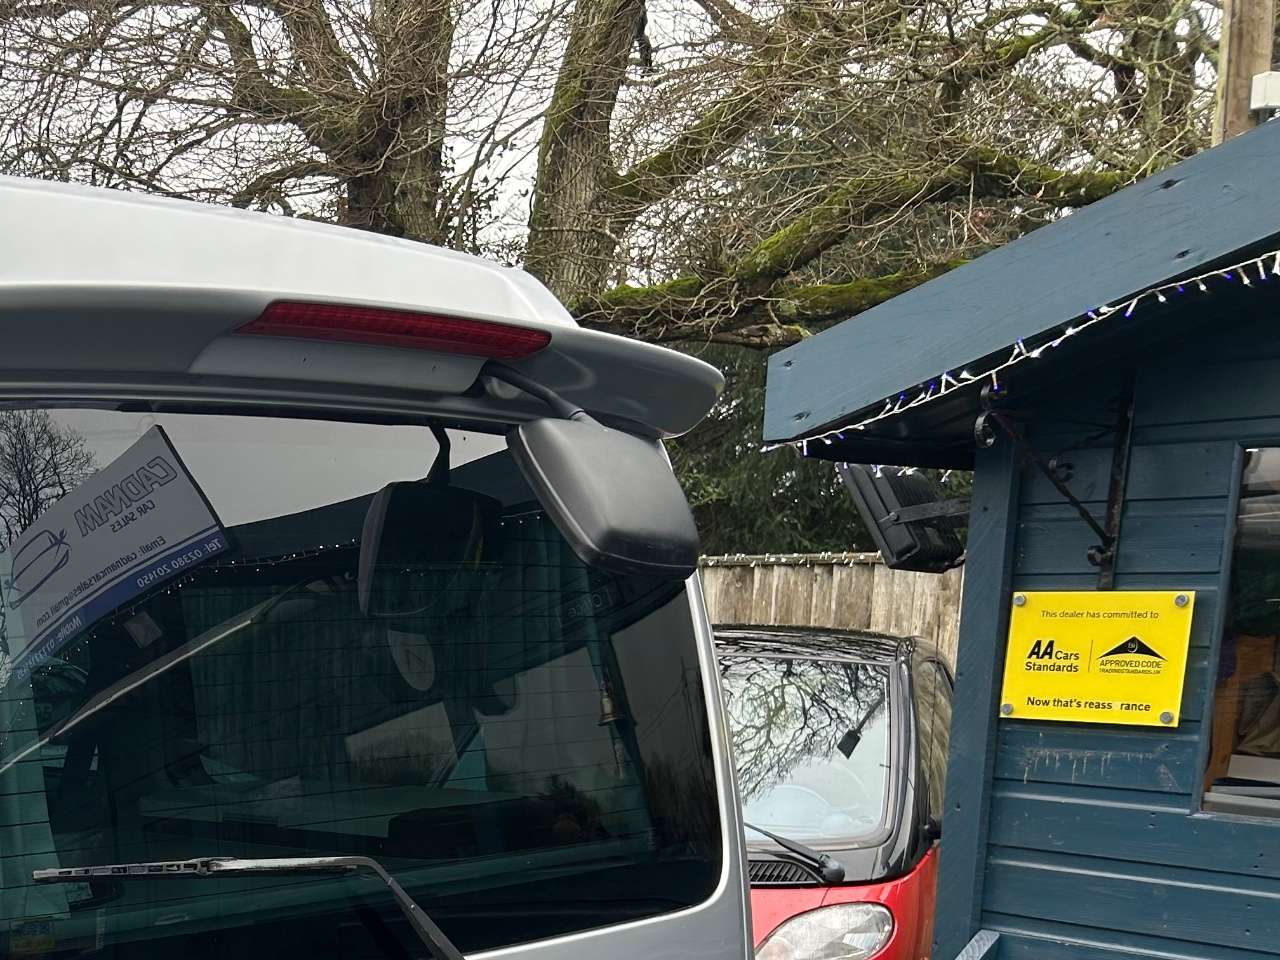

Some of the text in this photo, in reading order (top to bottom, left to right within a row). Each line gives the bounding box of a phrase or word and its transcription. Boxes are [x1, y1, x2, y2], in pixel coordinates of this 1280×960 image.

[1041, 610, 1158, 619] This dealer has committed to
[1027, 640, 1080, 661] AA Cars
[1024, 661, 1079, 673] Standards
[1099, 659, 1162, 669] APPROVED CODE
[1026, 697, 1050, 707] Now
[1052, 698, 1081, 709] that's
